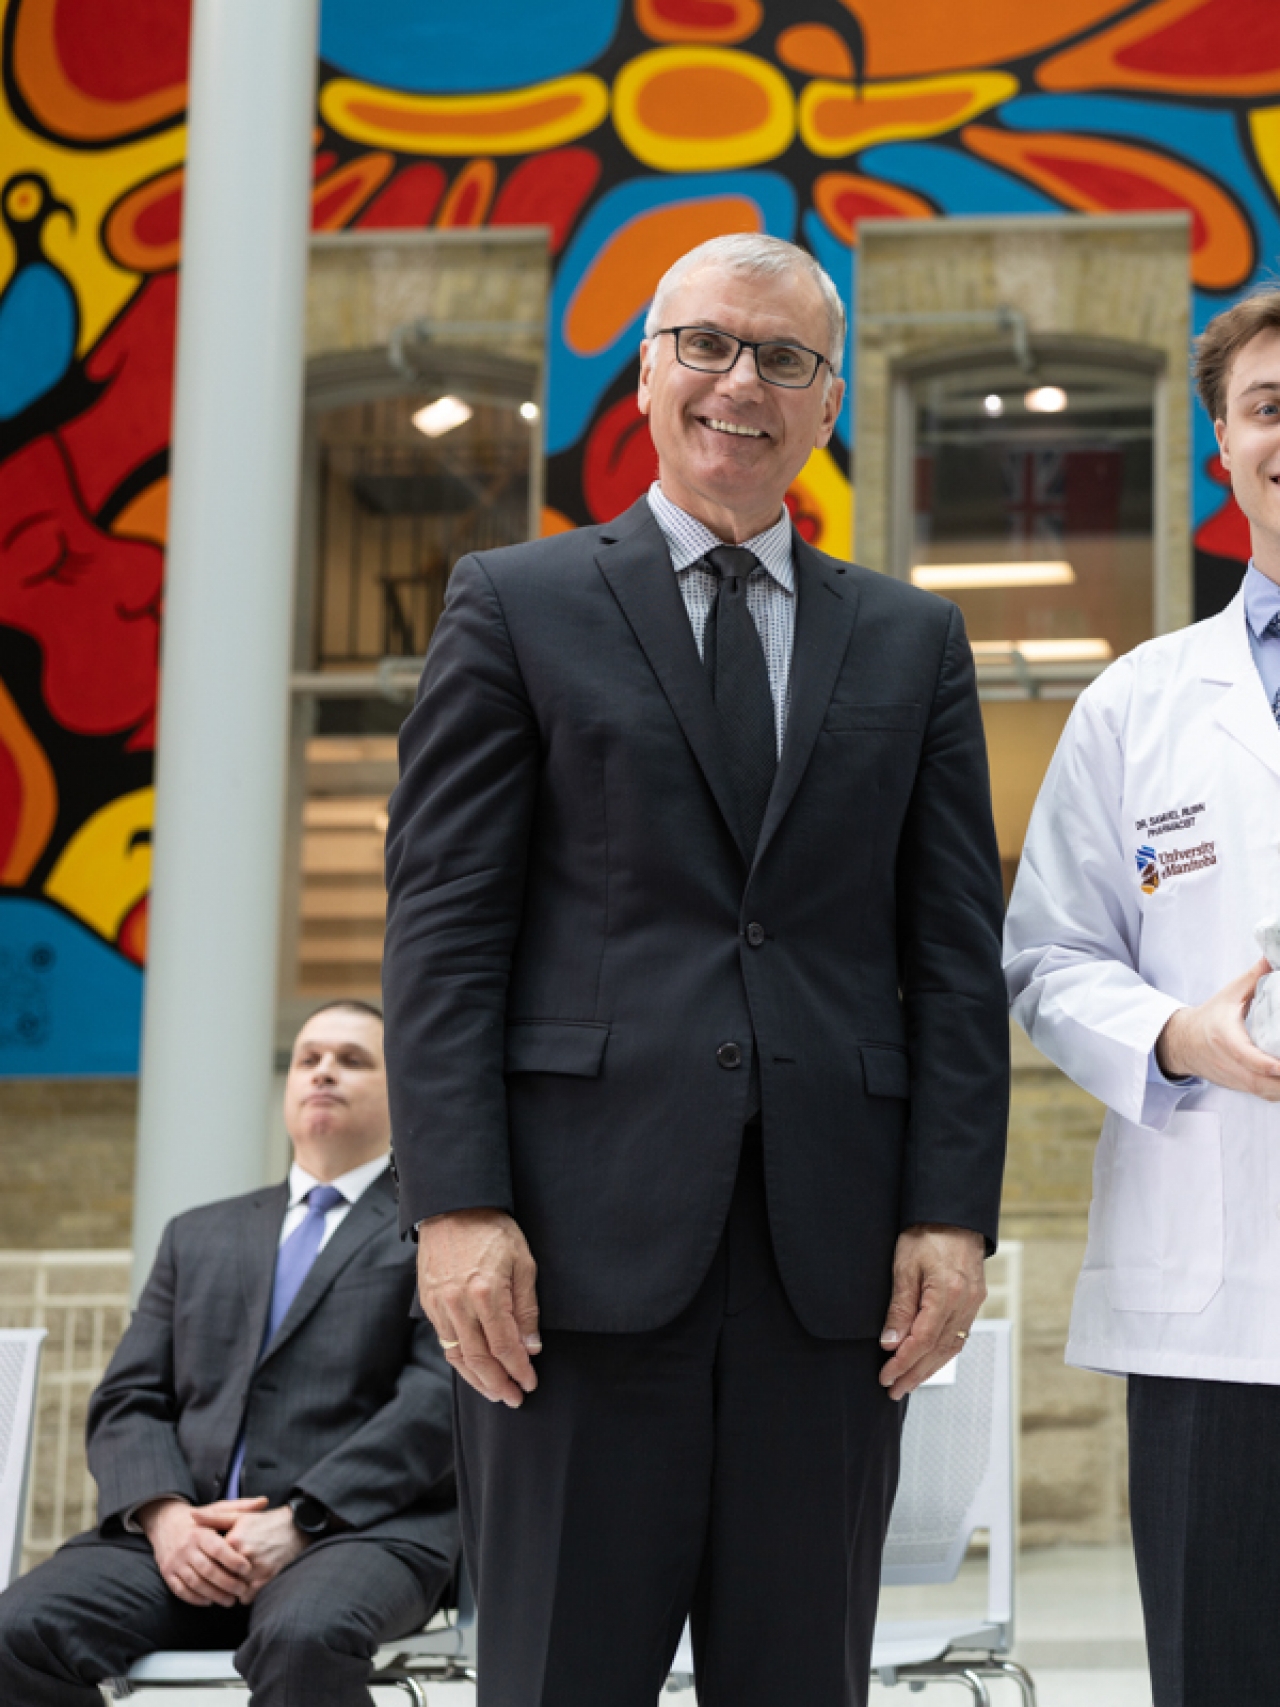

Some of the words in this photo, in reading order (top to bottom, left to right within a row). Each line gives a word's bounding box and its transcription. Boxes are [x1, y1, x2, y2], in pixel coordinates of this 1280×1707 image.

[1147, 816, 1196, 839] PHARMACIST
[1158, 841, 1215, 864] University
[1166, 855, 1217, 877] Manitoba
